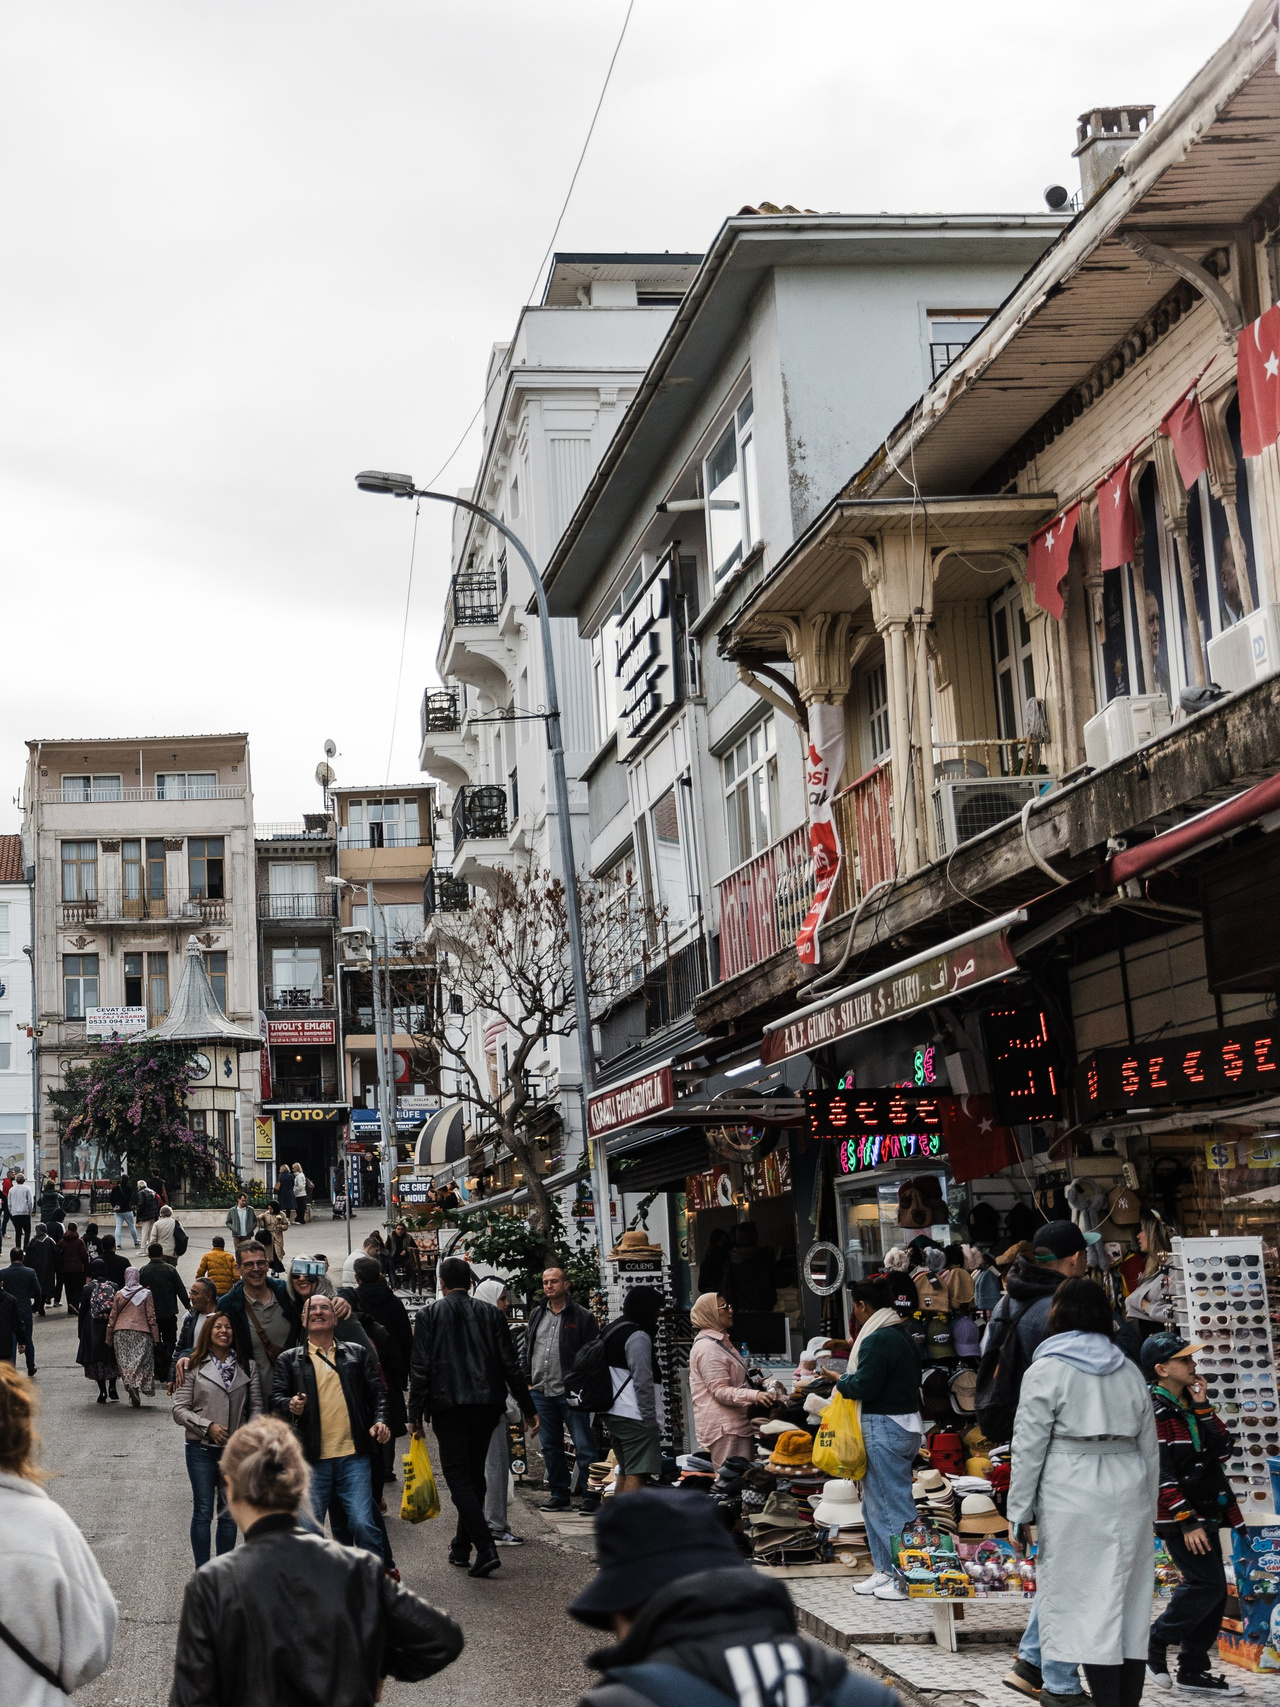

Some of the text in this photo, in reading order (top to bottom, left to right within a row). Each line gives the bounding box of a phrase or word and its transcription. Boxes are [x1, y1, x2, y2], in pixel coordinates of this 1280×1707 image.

[807, 1007, 836, 1045] GÜMÜŞ
[840, 992, 873, 1031] SILVER
[893, 973, 920, 1010] EURO
[270, 1022, 332, 1030] TIVOLI'S EMLAK
[281, 1109, 324, 1121] FOTO
[256, 1124, 273, 1144] FOTO
